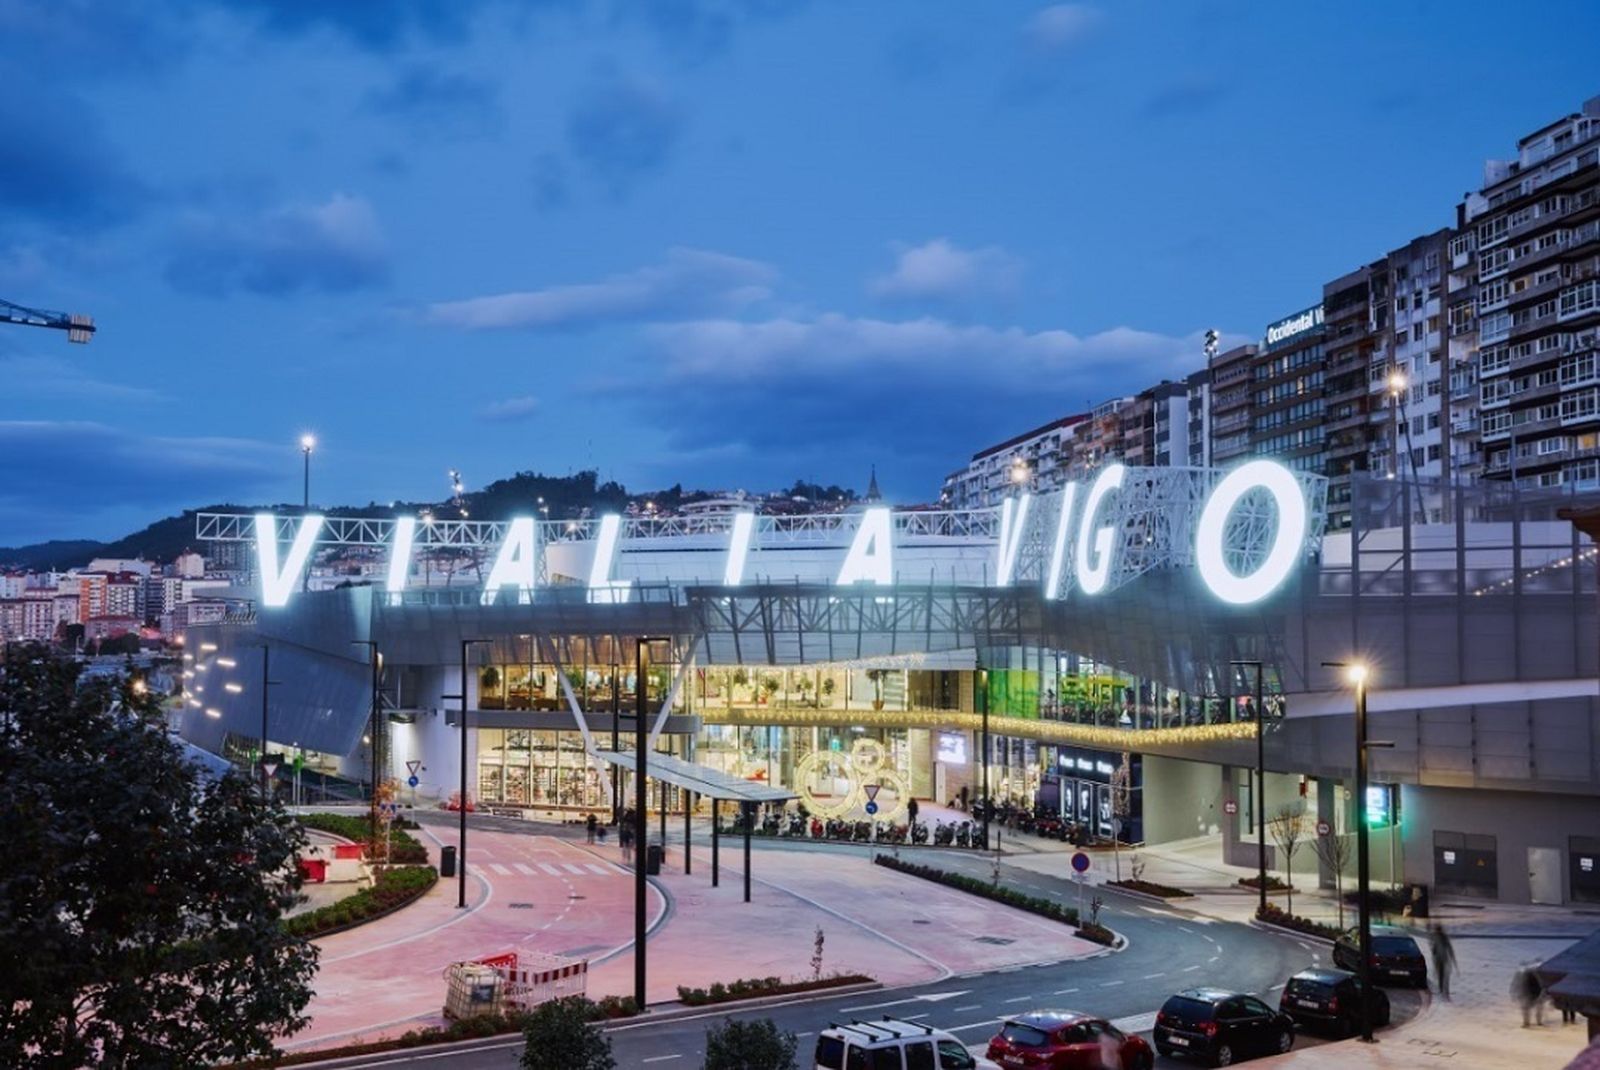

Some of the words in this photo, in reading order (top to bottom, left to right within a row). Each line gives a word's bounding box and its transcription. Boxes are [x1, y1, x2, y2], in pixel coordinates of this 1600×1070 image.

[1267, 309, 1314, 344] Occidental
[254, 507, 893, 607] VIALIA
[995, 459, 1306, 604] VIGO
